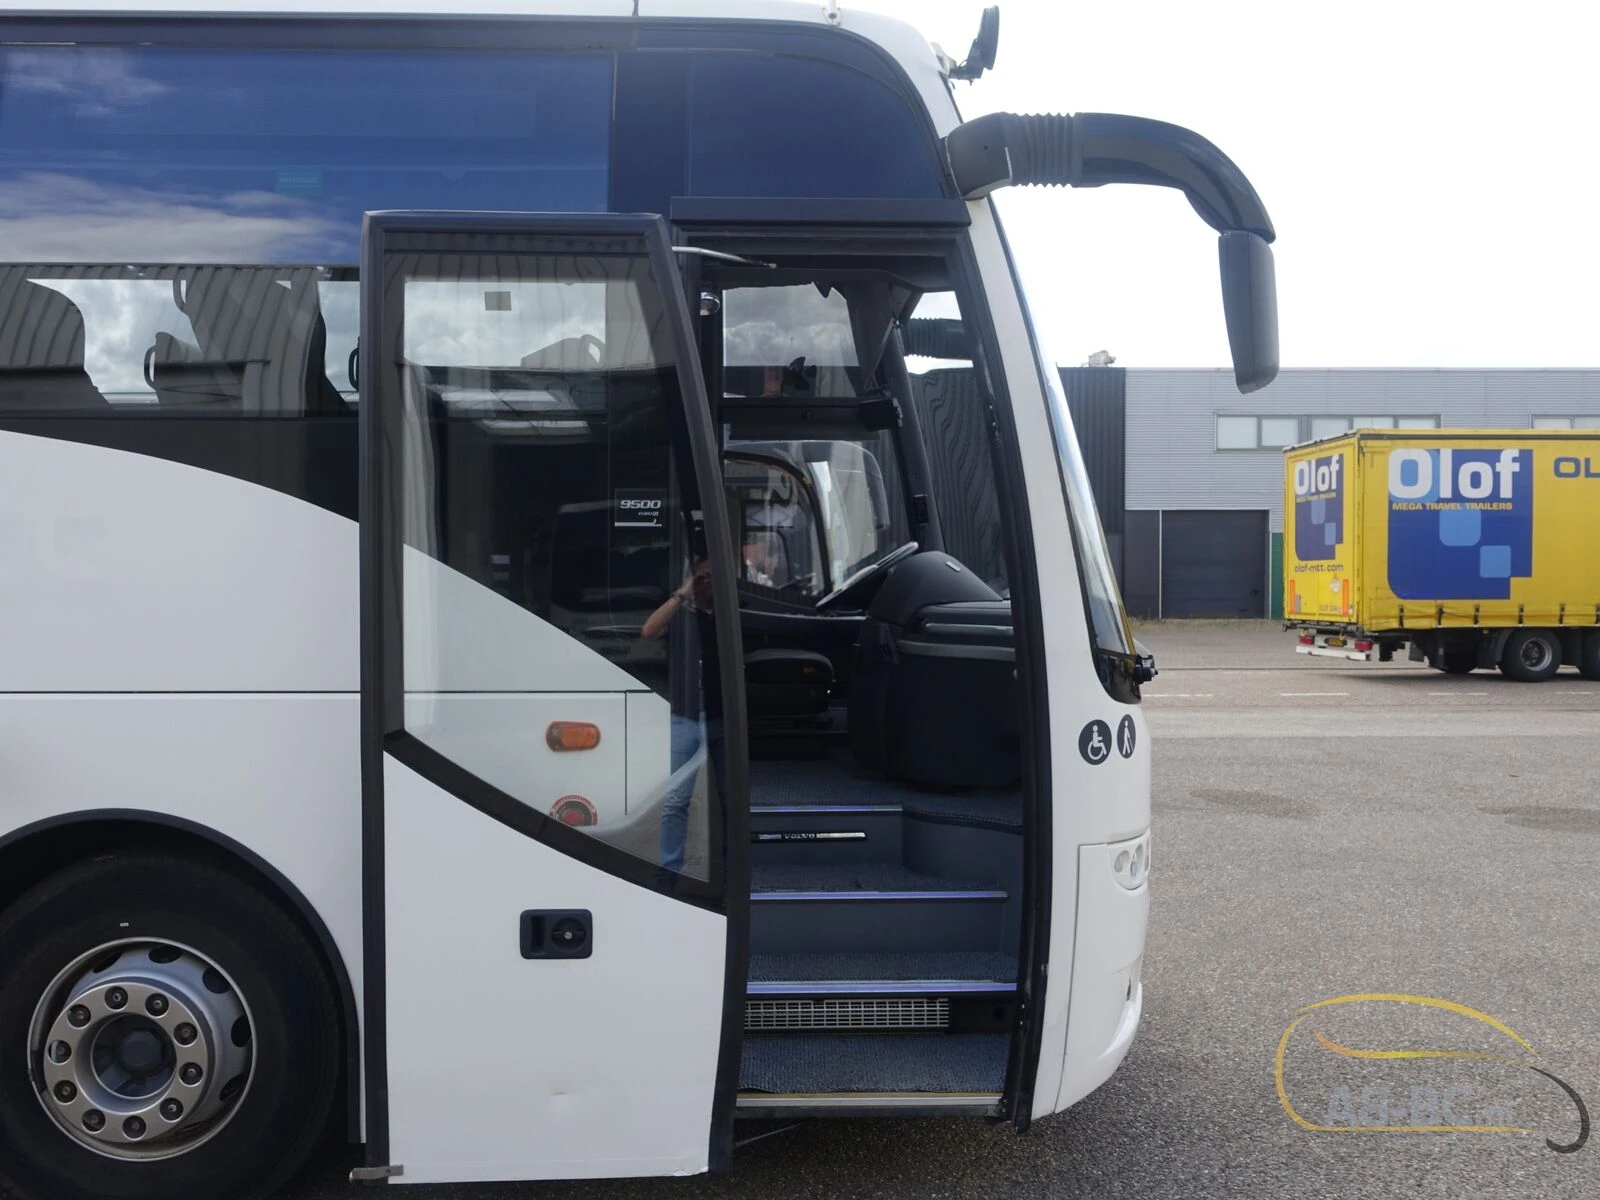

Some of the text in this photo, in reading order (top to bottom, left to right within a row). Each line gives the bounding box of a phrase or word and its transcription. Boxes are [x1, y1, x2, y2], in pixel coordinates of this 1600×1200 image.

[1294, 453, 1340, 496] Olof
[1388, 449, 1520, 499] Olof
[620, 500, 662, 509] 9500
[1392, 502, 1513, 511] MEGA TRAVEL TRAILERS
